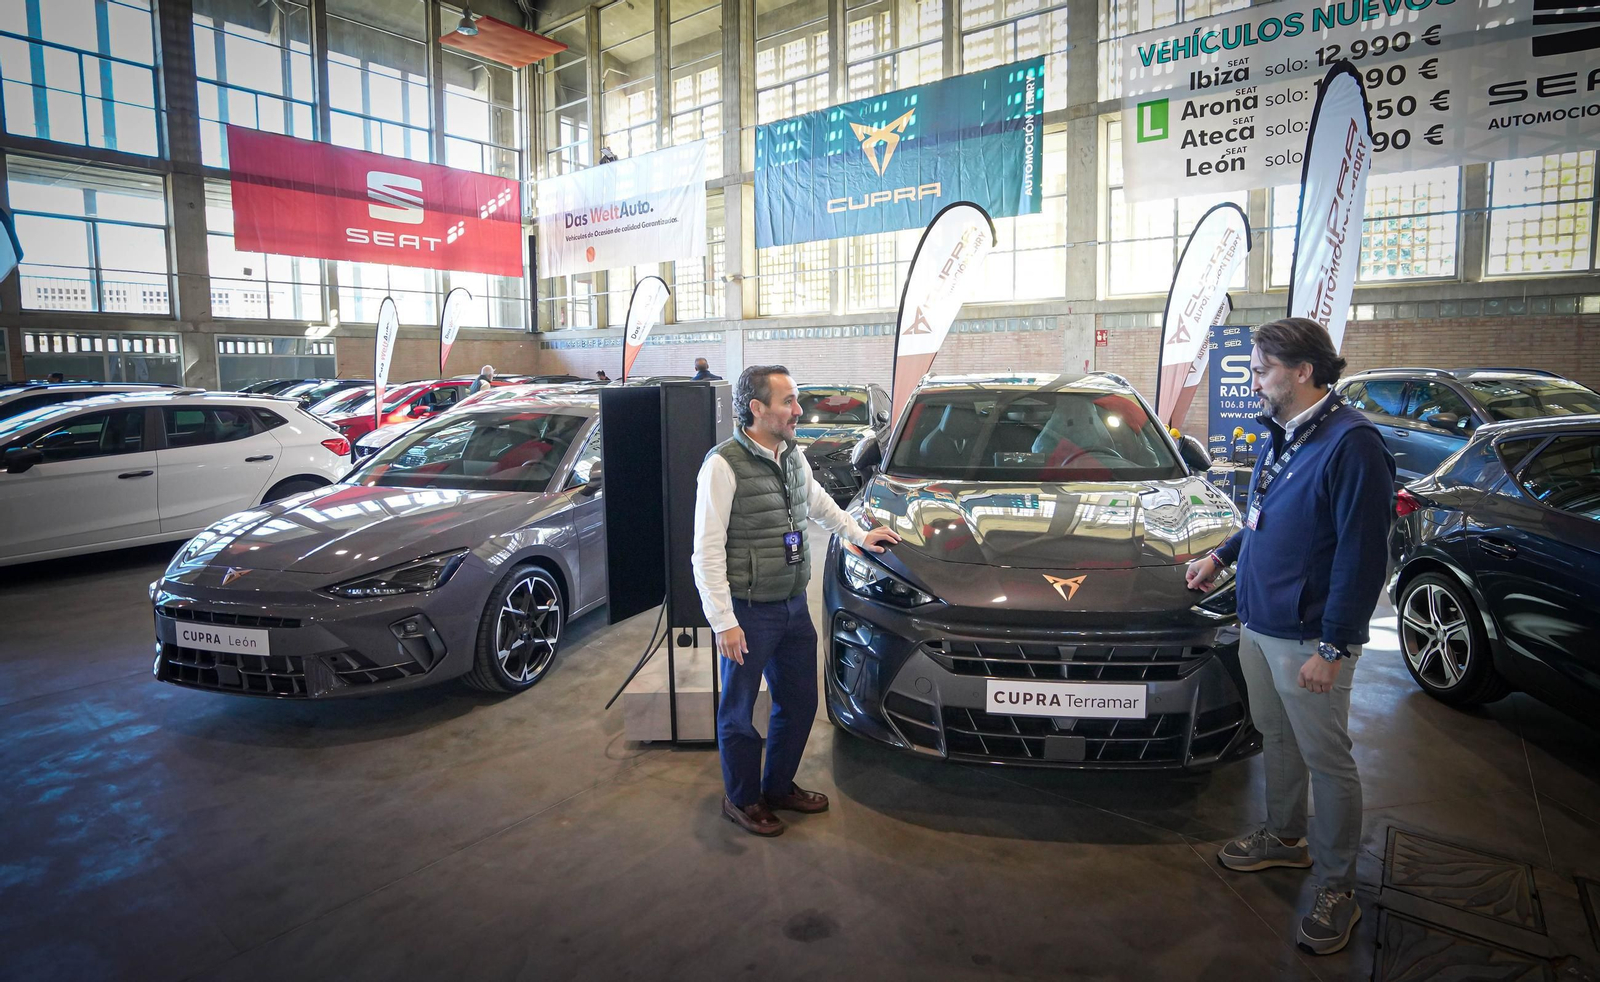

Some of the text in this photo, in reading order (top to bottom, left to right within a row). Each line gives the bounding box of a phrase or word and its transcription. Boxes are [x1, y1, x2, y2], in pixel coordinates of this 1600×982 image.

[1138, 0, 1456, 67] VEHÍCULOS NUEV
[1189, 24, 1442, 91] Ibiza solo: 12.990 €
[1227, 57, 1250, 68] SEAT
[1180, 95, 1259, 121] Arona
[1265, 88, 1309, 107] solo:
[1418, 58, 1439, 80] €
[1235, 86, 1258, 96] SEAT
[1180, 125, 1255, 149] Ateca
[1265, 119, 1309, 137] solo:
[1430, 89, 1450, 111] €
[1232, 115, 1255, 126] SEAT
[1023, 75, 1036, 196] AUTOMOCIÓN TERRY
[1186, 154, 1246, 177] León
[1423, 124, 1444, 145] €
[1225, 146, 1248, 156] SEAT
[826, 182, 942, 215] CUPRA
[565, 200, 654, 229] Das WeltAuto.
[345, 227, 442, 252] SEAT
[587, 231, 594, 239] de
[614, 225, 621, 233] de
[1220, 401, 1244, 409] 106.8
[1291, 423, 1318, 452] MOTORSUR
[183, 630, 257, 648] CUPRA León
[993, 690, 1140, 709] CUPRA Terramar
